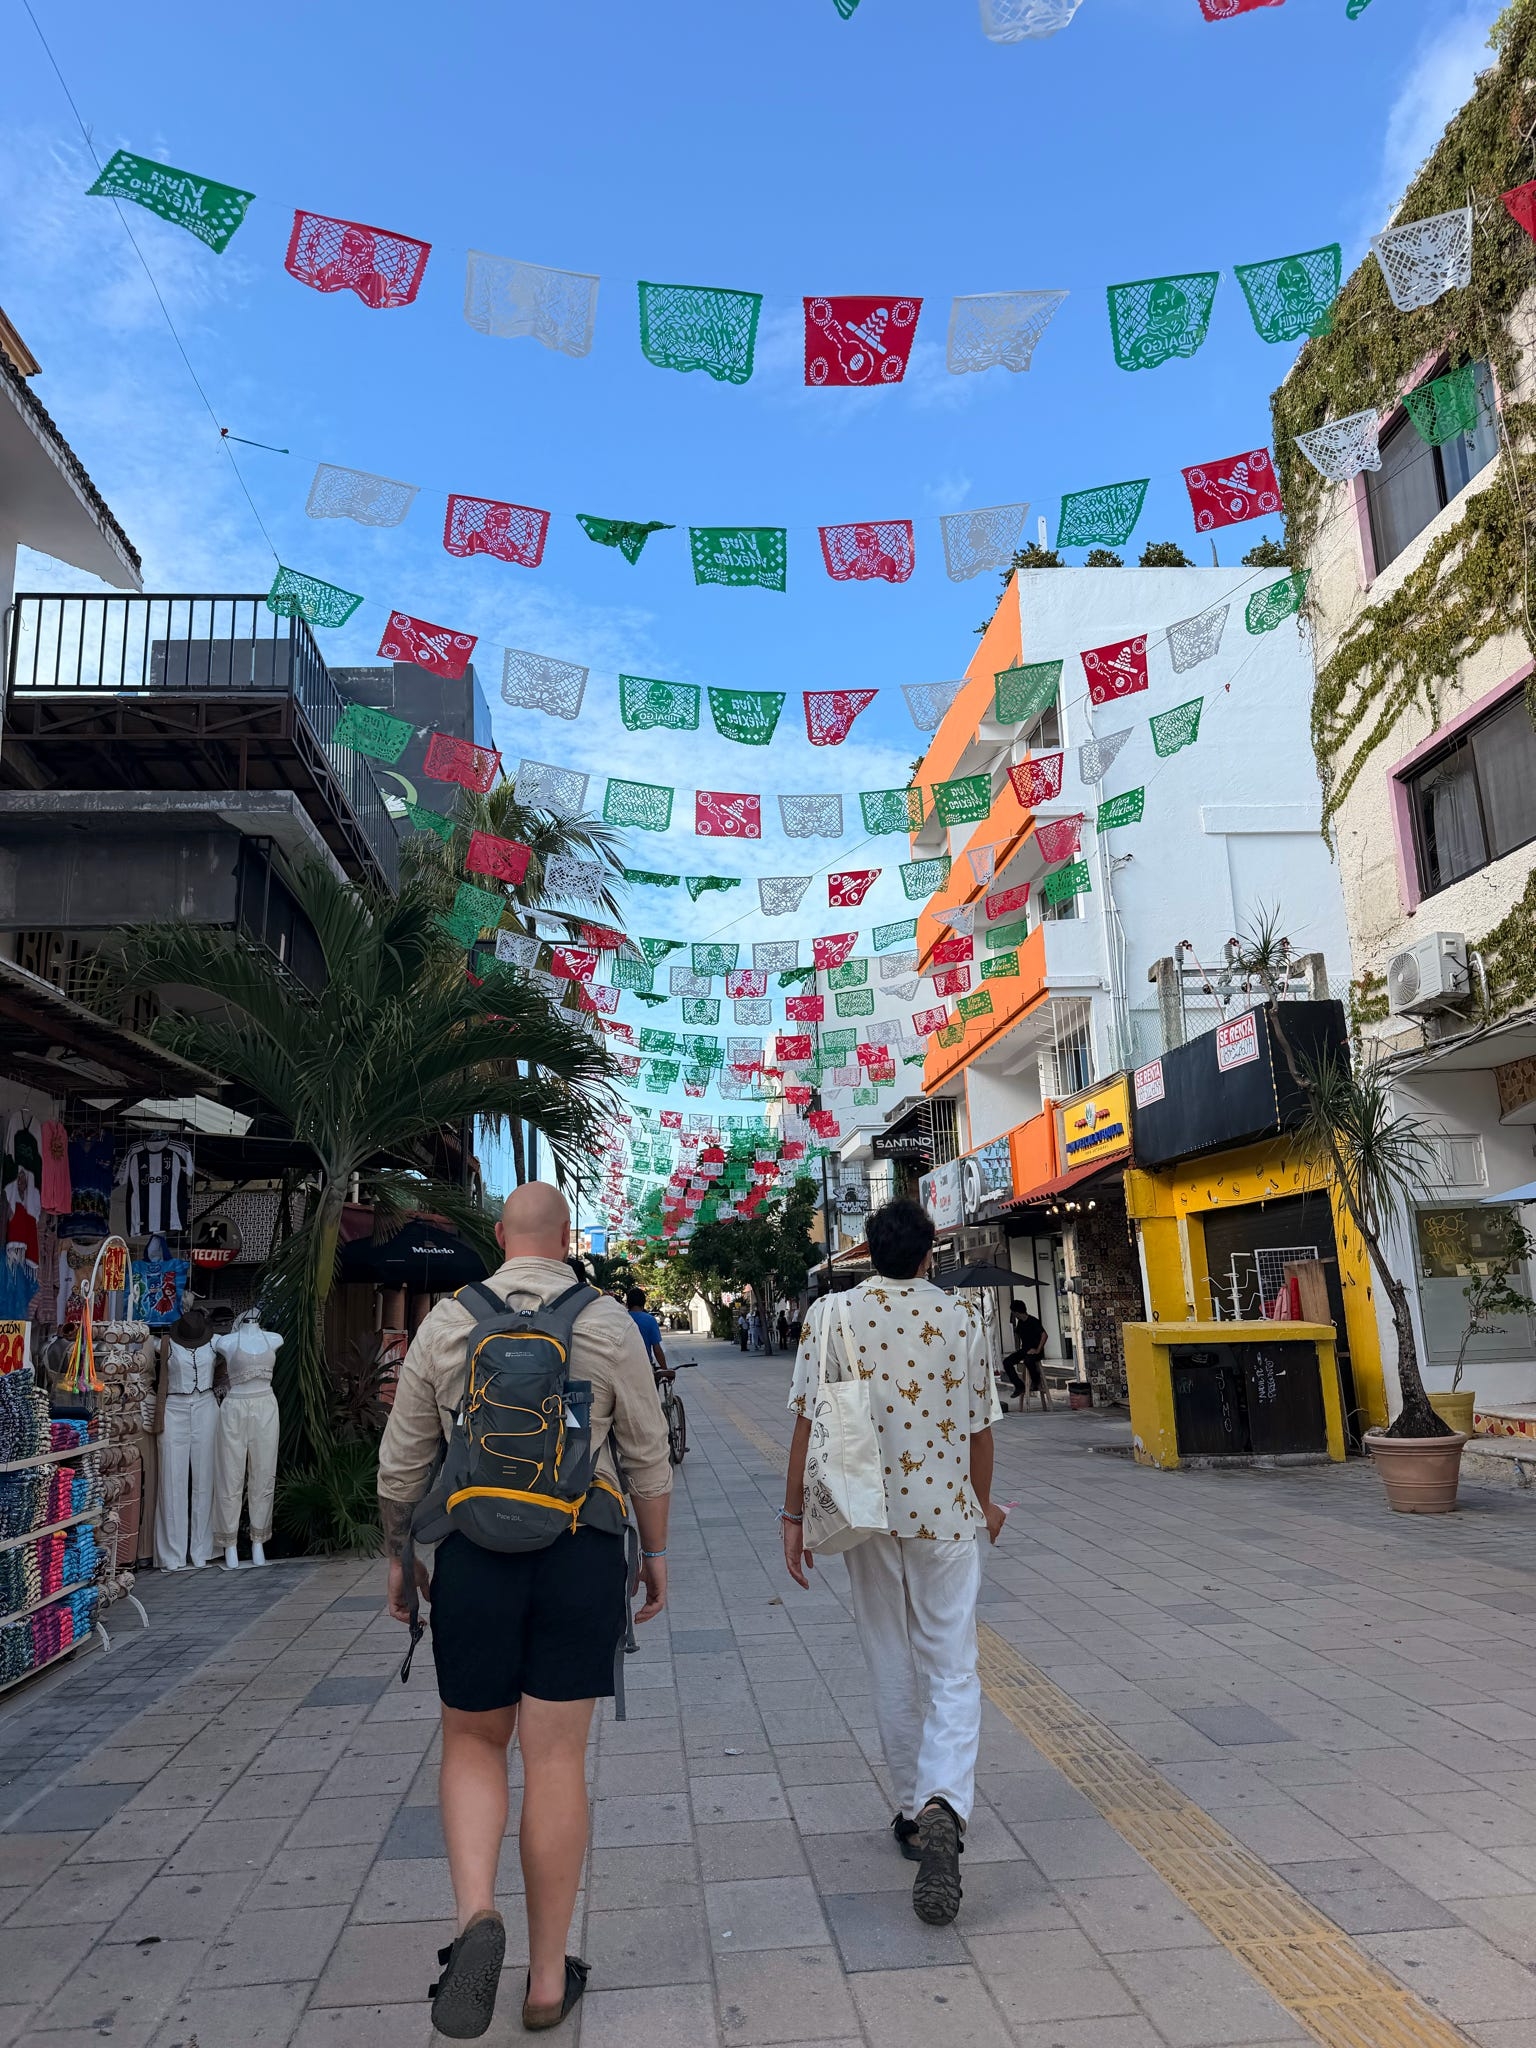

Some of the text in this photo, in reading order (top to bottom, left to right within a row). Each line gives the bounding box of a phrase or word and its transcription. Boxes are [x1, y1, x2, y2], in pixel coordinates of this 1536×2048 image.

[1278, 310, 1323, 328] HIDALGO
[1111, 796, 1130, 809] Viva
[1219, 1018, 1253, 1047] SE RENTA
[1136, 1073, 1144, 1088] SE
[875, 1137, 932, 1149] SANTINO
[140, 1175, 170, 1185] Jeep
[836, 1201, 868, 1209] BOWLING
[192, 1249, 231, 1261] TECATE
[411, 1246, 455, 1255] Modelo
